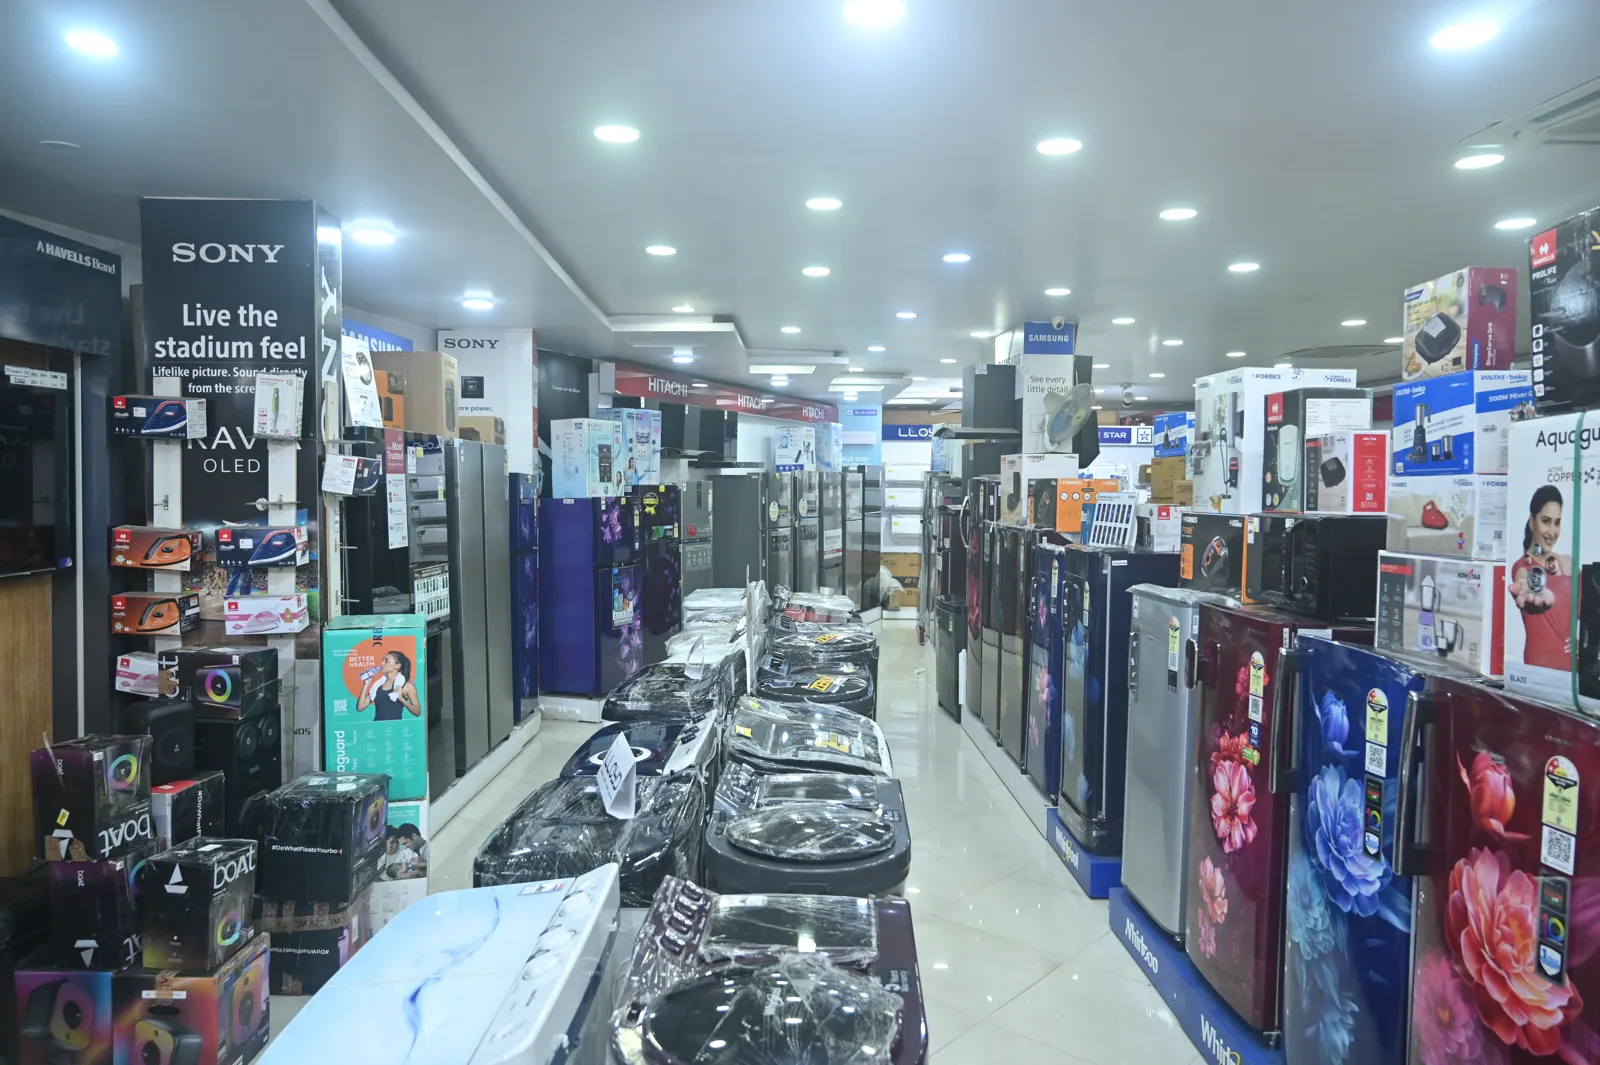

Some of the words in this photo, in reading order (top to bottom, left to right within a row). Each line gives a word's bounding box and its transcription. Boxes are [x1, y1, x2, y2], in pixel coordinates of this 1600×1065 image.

[36, 240, 45, 253] A
[46, 243, 91, 267] HAVELLS
[92, 258, 116, 275] Brand
[172, 243, 284, 263] SONY
[1532, 265, 1557, 280] PROLIFE
[182, 303, 231, 328] Live
[238, 303, 278, 327] the
[444, 339, 499, 349] SONY
[1028, 334, 1069, 342] SAMSUNG
[154, 335, 253, 360] stadium
[260, 335, 306, 359] feel
[153, 366, 190, 377] Lifelike
[192, 366, 231, 379] picture.
[1029, 375, 1044, 383] See
[1045, 376, 1067, 384] every
[1509, 373, 1528, 382] beko
[188, 383, 216, 394] from
[218, 382, 233, 394] the
[648, 376, 688, 397] HITACHI
[1027, 385, 1046, 393] little
[737, 394, 767, 410] HITACHI
[802, 405, 825, 419] HITACHI
[203, 458, 261, 473] OLED
[1457, 569, 1481, 580] KENSTAR
[1509, 675, 1527, 684] BLAZE
[98, 813, 152, 858] boAt
[1055, 825, 1080, 870] Whirlpool
[213, 844, 256, 890] boAt
